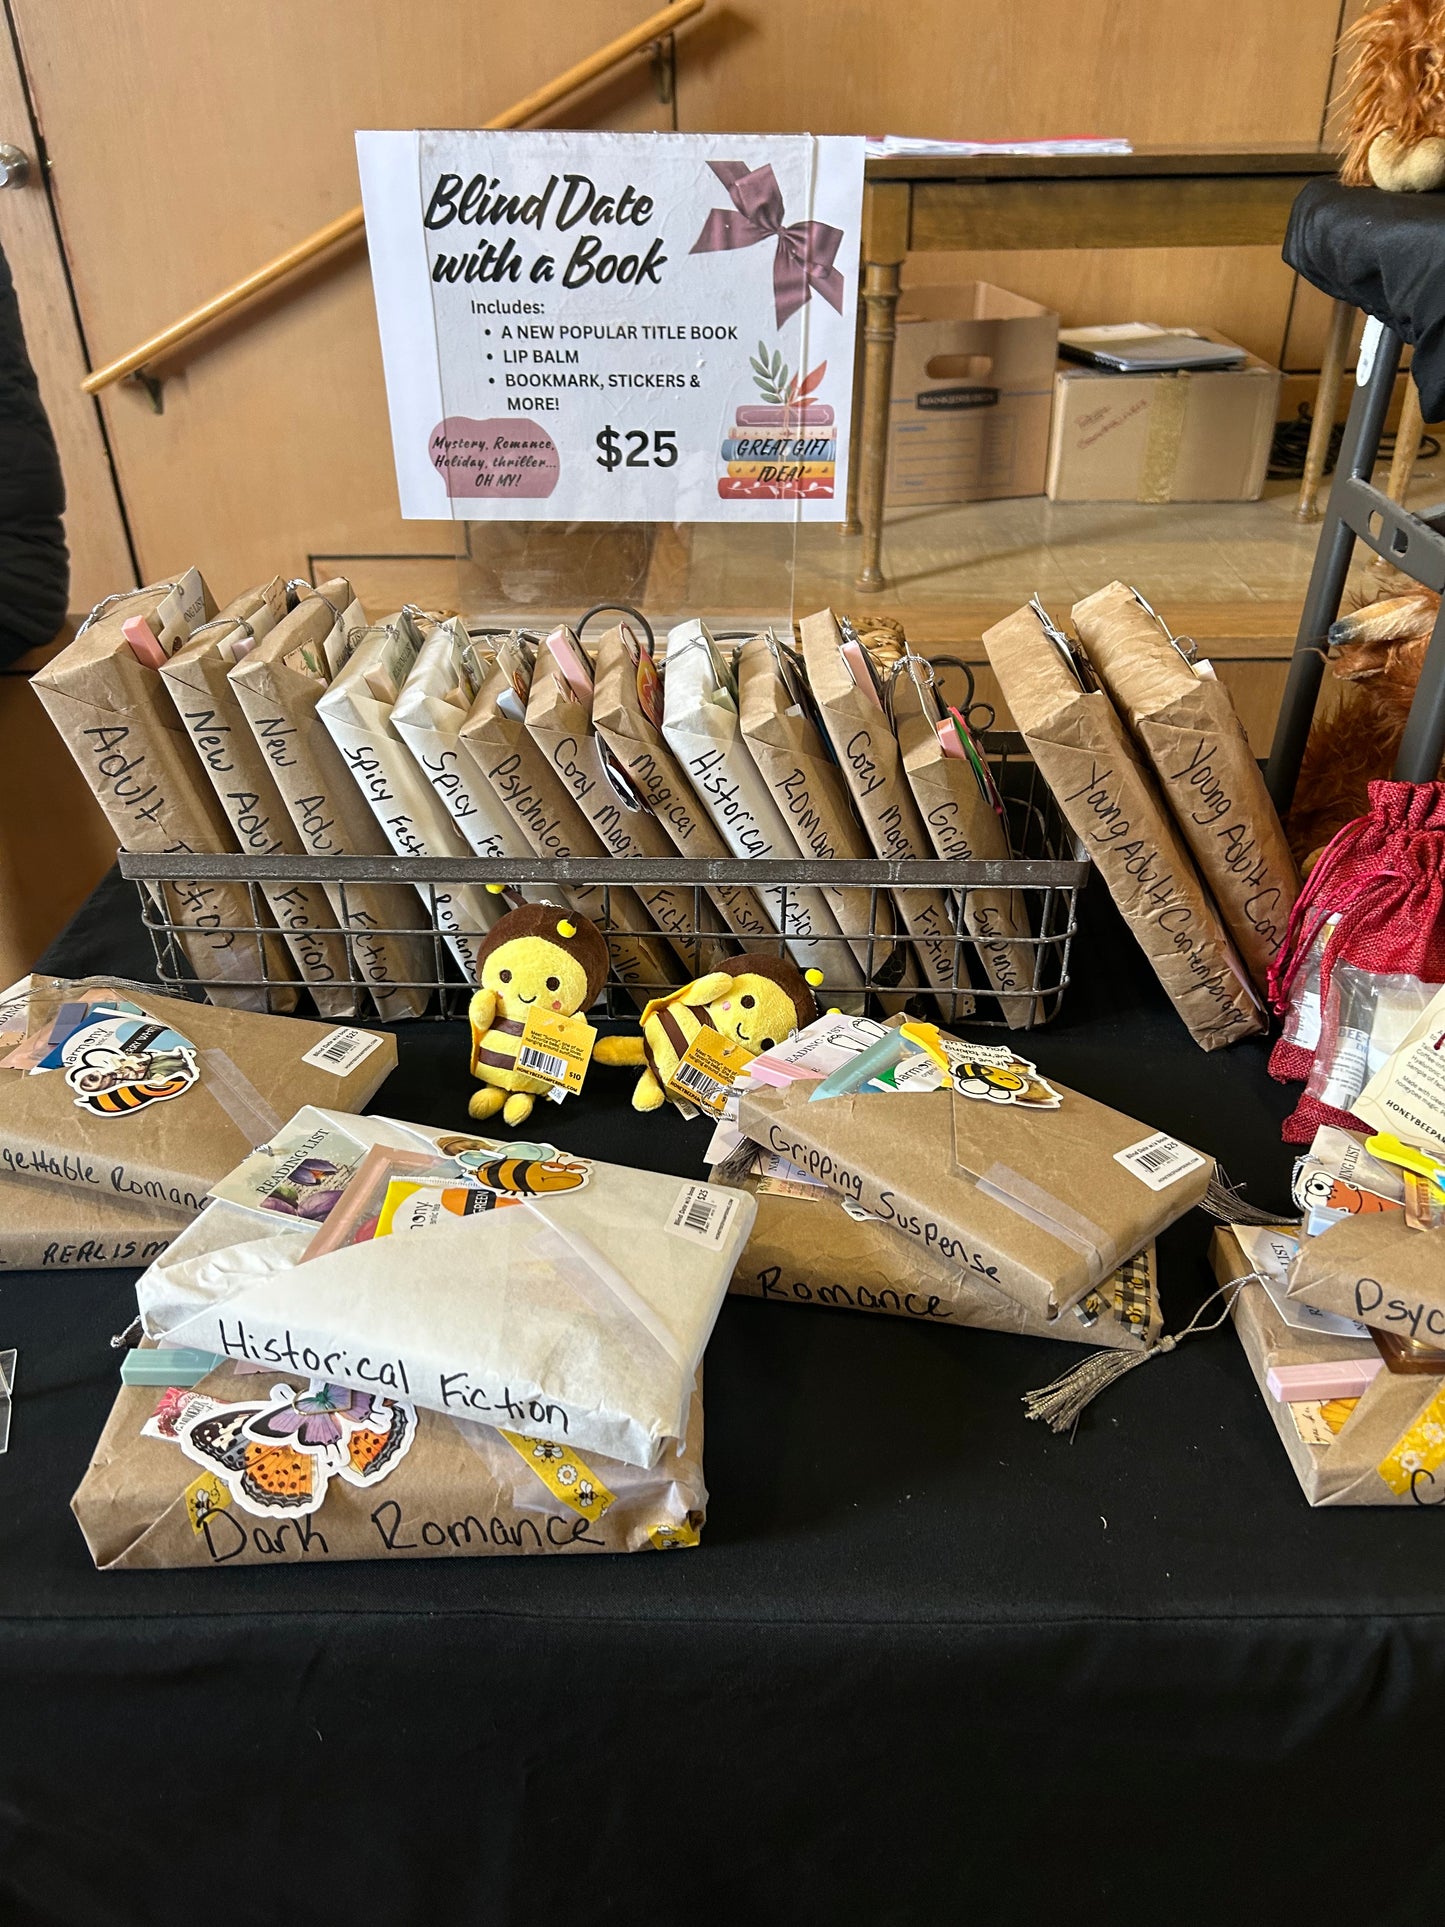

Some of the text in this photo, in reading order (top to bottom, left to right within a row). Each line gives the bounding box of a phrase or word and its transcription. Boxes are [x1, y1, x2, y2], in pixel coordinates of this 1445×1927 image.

[424, 174, 654, 232] Blind Date
[432, 235, 668, 289] with a Book
[471, 299, 545, 315] Includes:
[501, 325, 738, 340] A NEW POPULAR TITLE BOOK
[504, 350, 579, 363] LIP BALM
[505, 374, 701, 390] BOOKMARK, STICKERS &
[507, 398, 559, 411] MORE!
[432, 437, 555, 451] Mystery, Romance,
[434, 455, 488, 468] Holiday,
[596, 425, 678, 472] $25
[737, 439, 830, 456] GREAT GIFT
[475, 474, 521, 487] OH MY!
[757, 466, 805, 482] IDEA!
[254, 717, 297, 767] New
[847, 730, 886, 797] Cozy
[83, 726, 165, 823] Adult
[344, 747, 393, 801] Spicy
[422, 751, 477, 818] Spicy
[554, 737, 596, 801] Cozy
[628, 753, 698, 839] Magical
[687, 748, 772, 858] Historical
[1171, 738, 1231, 825] Young
[1217, 823, 1268, 888] Adult
[185, 710, 234, 772] New
[273, 886, 334, 983] Fiction
[1065, 760, 1248, 1032] Young Adult Contemporary
[569, 1072, 581, 1080] $10
[256, 1128, 330, 1194] READING LIST
[1165, 1142, 1177, 1150] $25
[1344, 1144, 1360, 1163] LIST
[698, 1190, 707, 1200] $25
[769, 1123, 1001, 1284] Gripping Suspense
[42, 1240, 170, 1266] REALISM
[757, 1266, 953, 1317] Romance
[219, 1319, 569, 1436] Historical Fiction
[195, 1500, 606, 1565] Dark Romance
